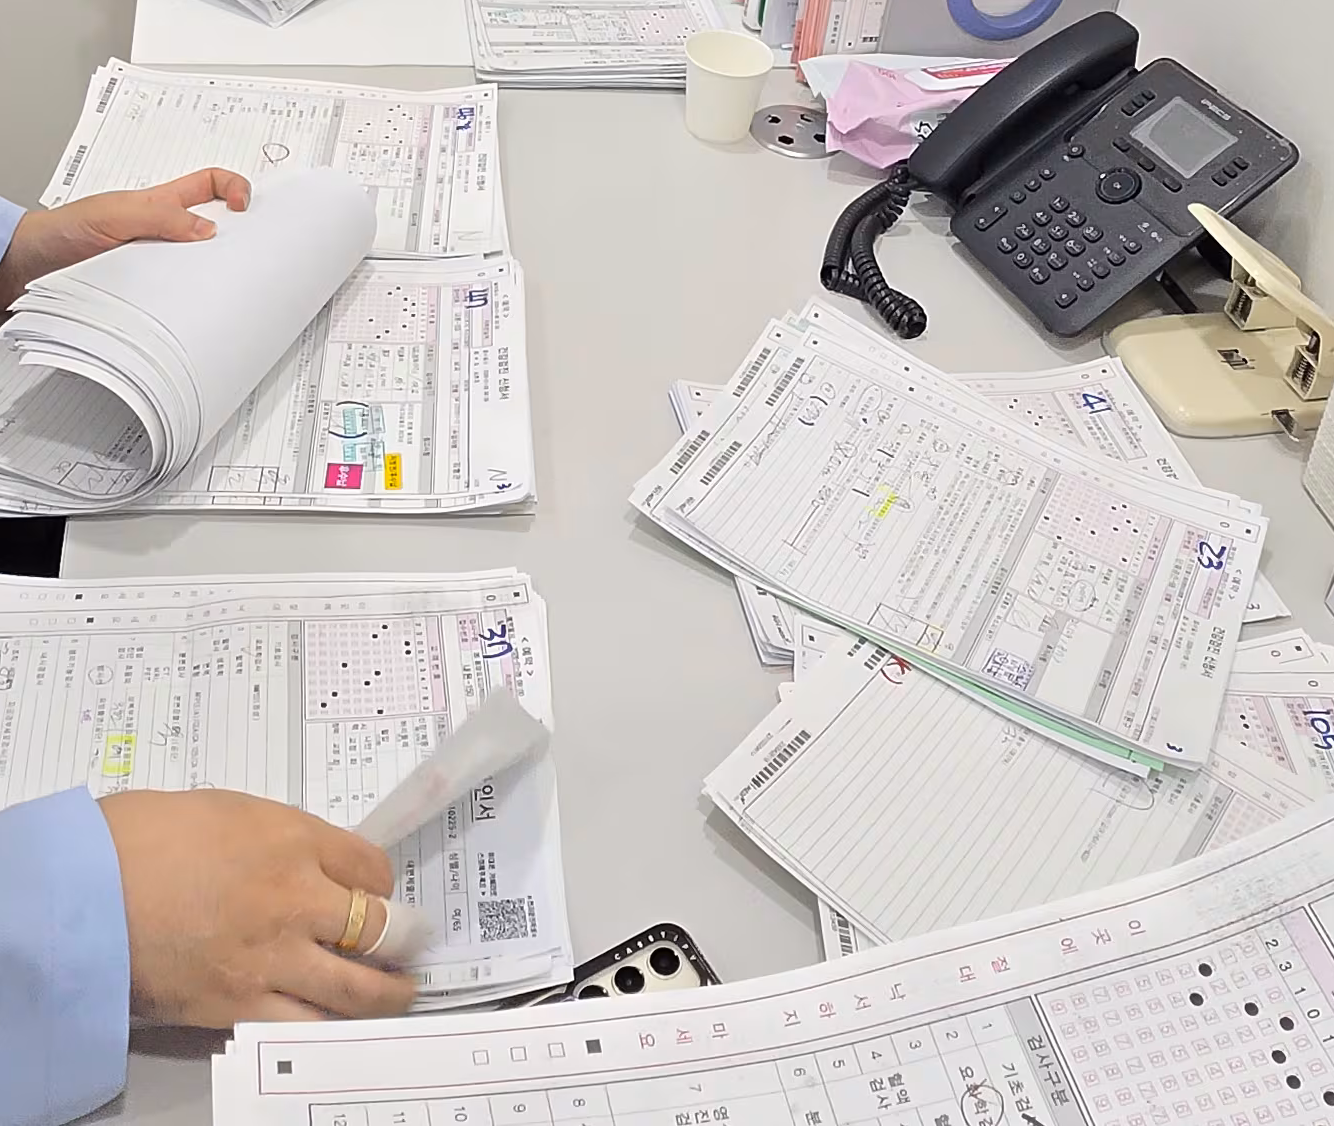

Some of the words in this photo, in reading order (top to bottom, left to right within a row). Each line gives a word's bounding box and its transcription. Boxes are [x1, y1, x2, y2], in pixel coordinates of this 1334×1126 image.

[1198, 540, 1227, 569] 23
[945, 1030, 959, 1040] 2
[909, 1040, 922, 1050] 3
[871, 1050, 883, 1060] 4
[832, 1059, 845, 1069] 5
[793, 1066, 806, 1077] 6
[1027, 1035, 1069, 1106] 검사구분
[870, 1077, 892, 1110] 검사
[887, 1072, 911, 1105] 혈액
[513, 1103, 526, 1113] 9
[572, 1098, 586, 1108] 8
[453, 1106, 468, 1122] 10
